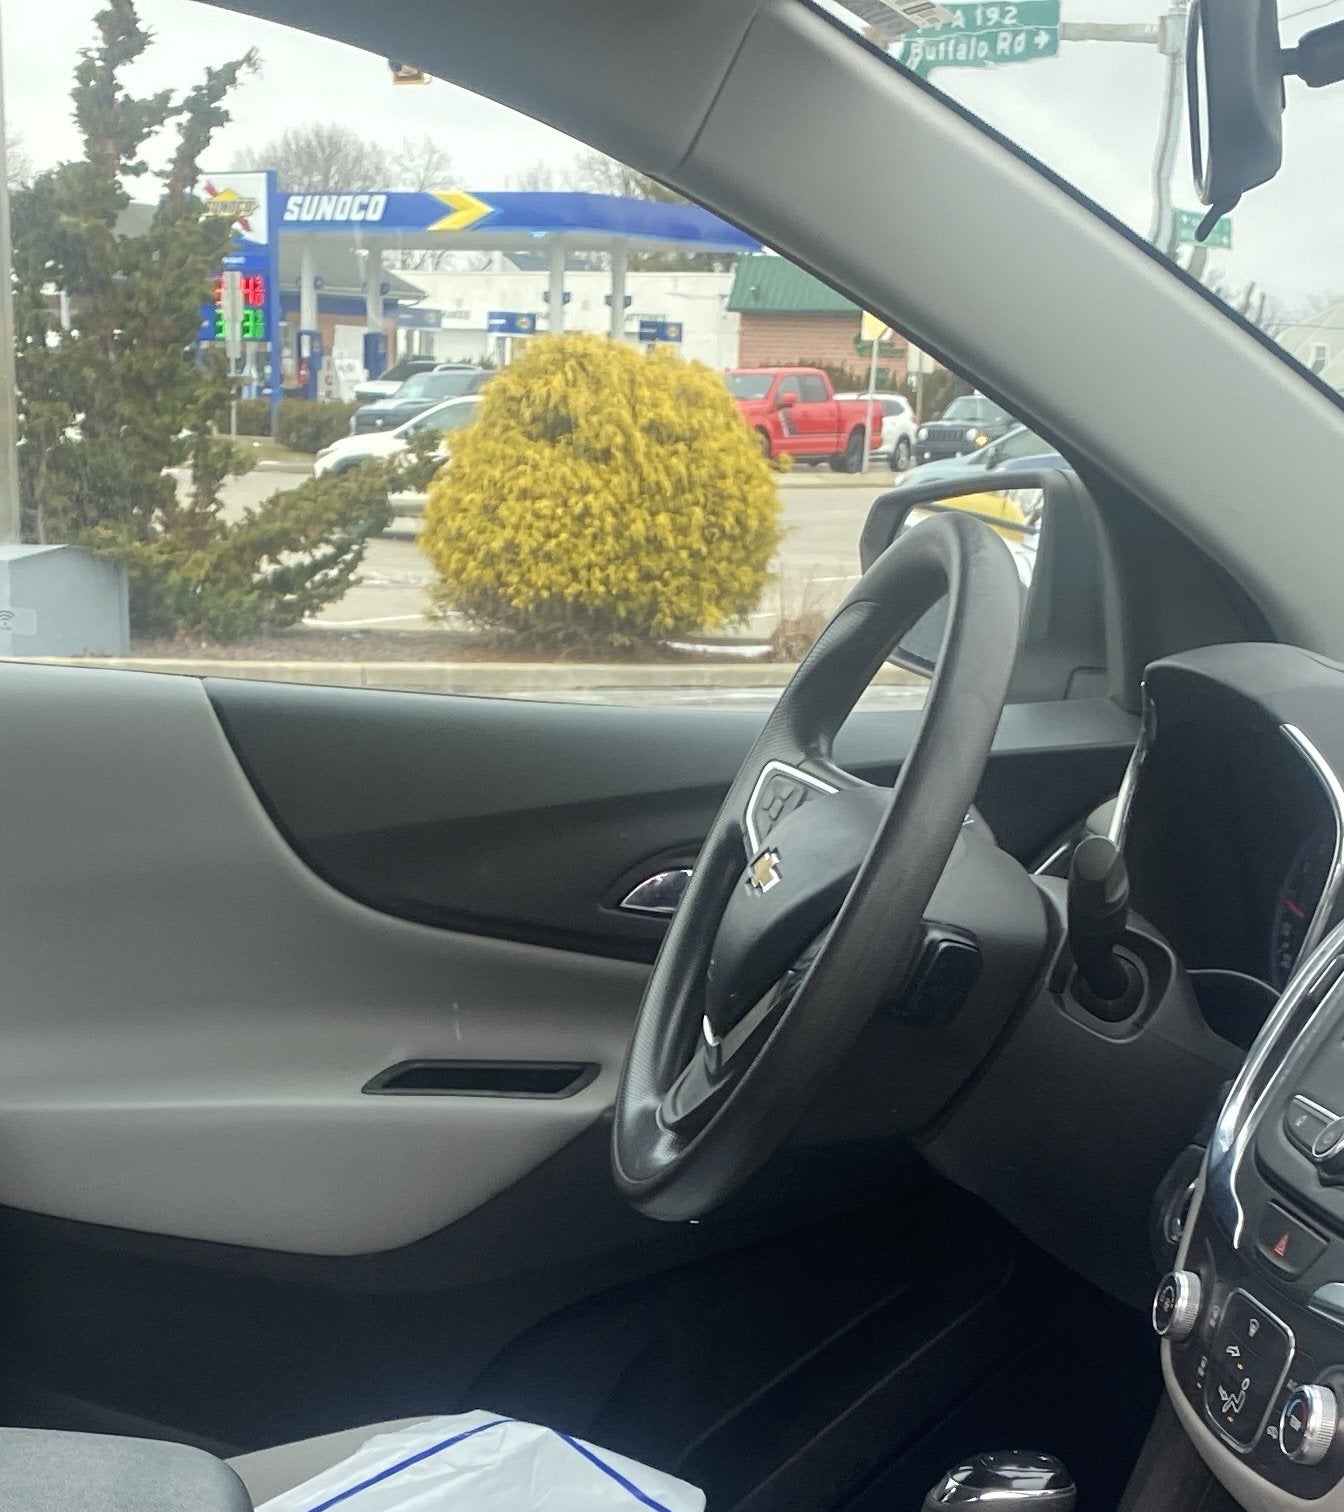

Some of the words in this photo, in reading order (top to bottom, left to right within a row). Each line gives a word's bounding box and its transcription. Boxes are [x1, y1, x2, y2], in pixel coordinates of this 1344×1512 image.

[975, 6, 1018, 26] 192
[910, 36, 989, 62] Buffalo
[996, 32, 1026, 56] Rd
[283, 194, 387, 221] SUNOCO
